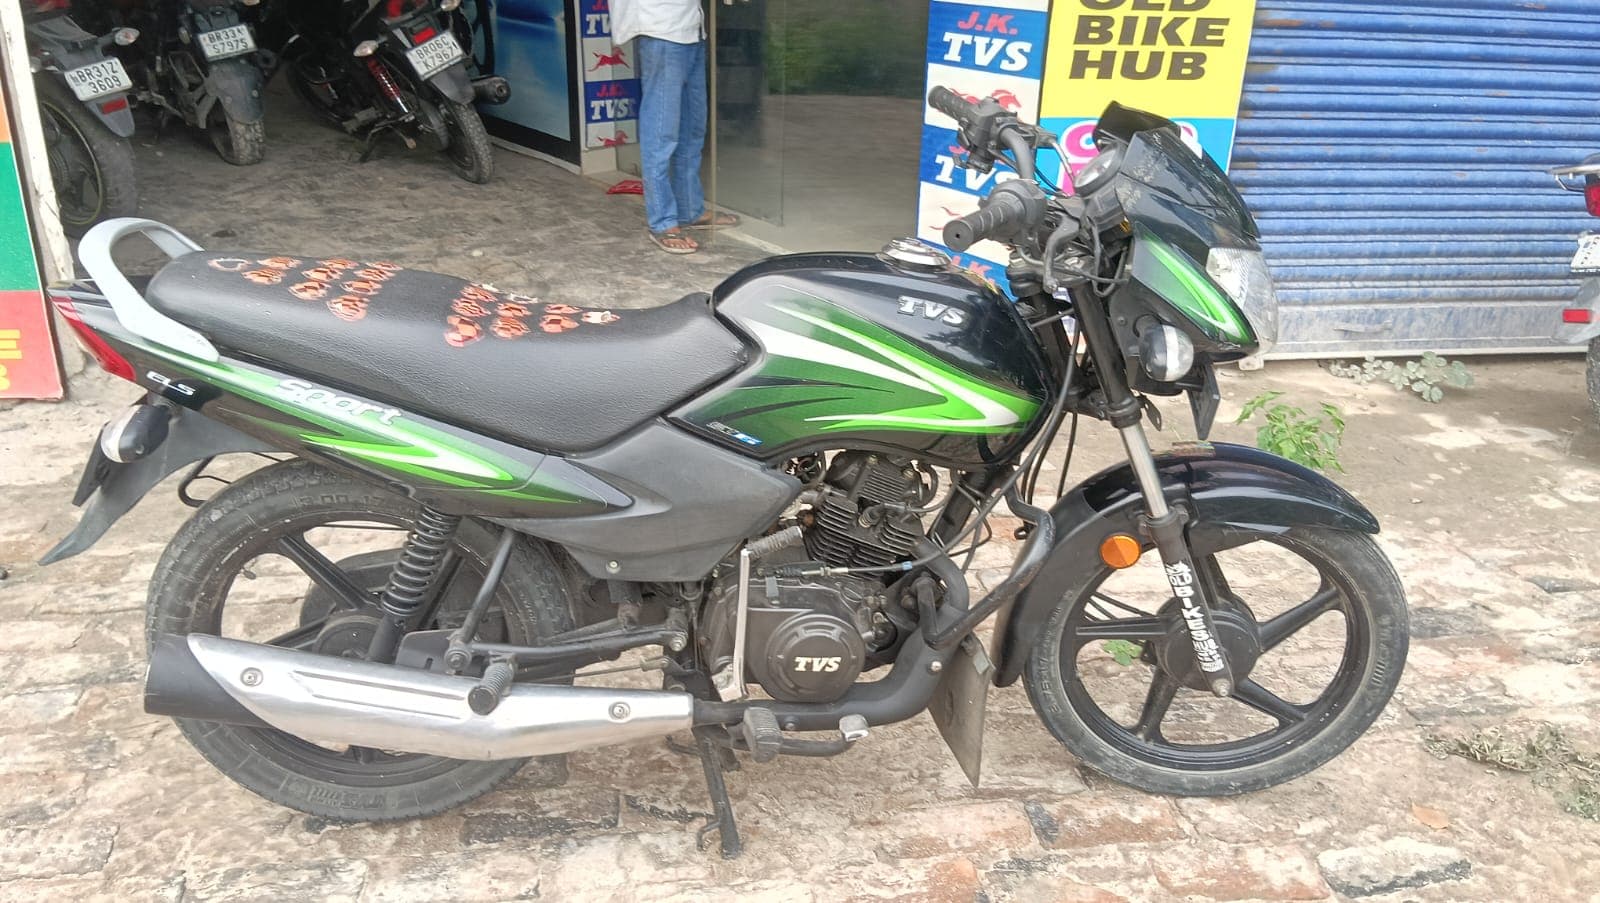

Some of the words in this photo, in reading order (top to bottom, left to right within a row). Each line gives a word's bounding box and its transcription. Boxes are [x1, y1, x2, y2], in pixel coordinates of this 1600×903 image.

[957, 11, 1019, 36] J.K.
[1073, 15, 1230, 47] BIKE
[415, 35, 449, 60] BR06C
[422, 45, 455, 71] K7967
[943, 31, 1033, 72] TVS
[76, 61, 119, 83] BR31Z
[1069, 50, 1207, 80] HUB
[88, 75, 122, 94] 3609
[897, 295, 968, 326] TVS
[278, 378, 403, 427] Sport
[794, 656, 842, 672] TVS
